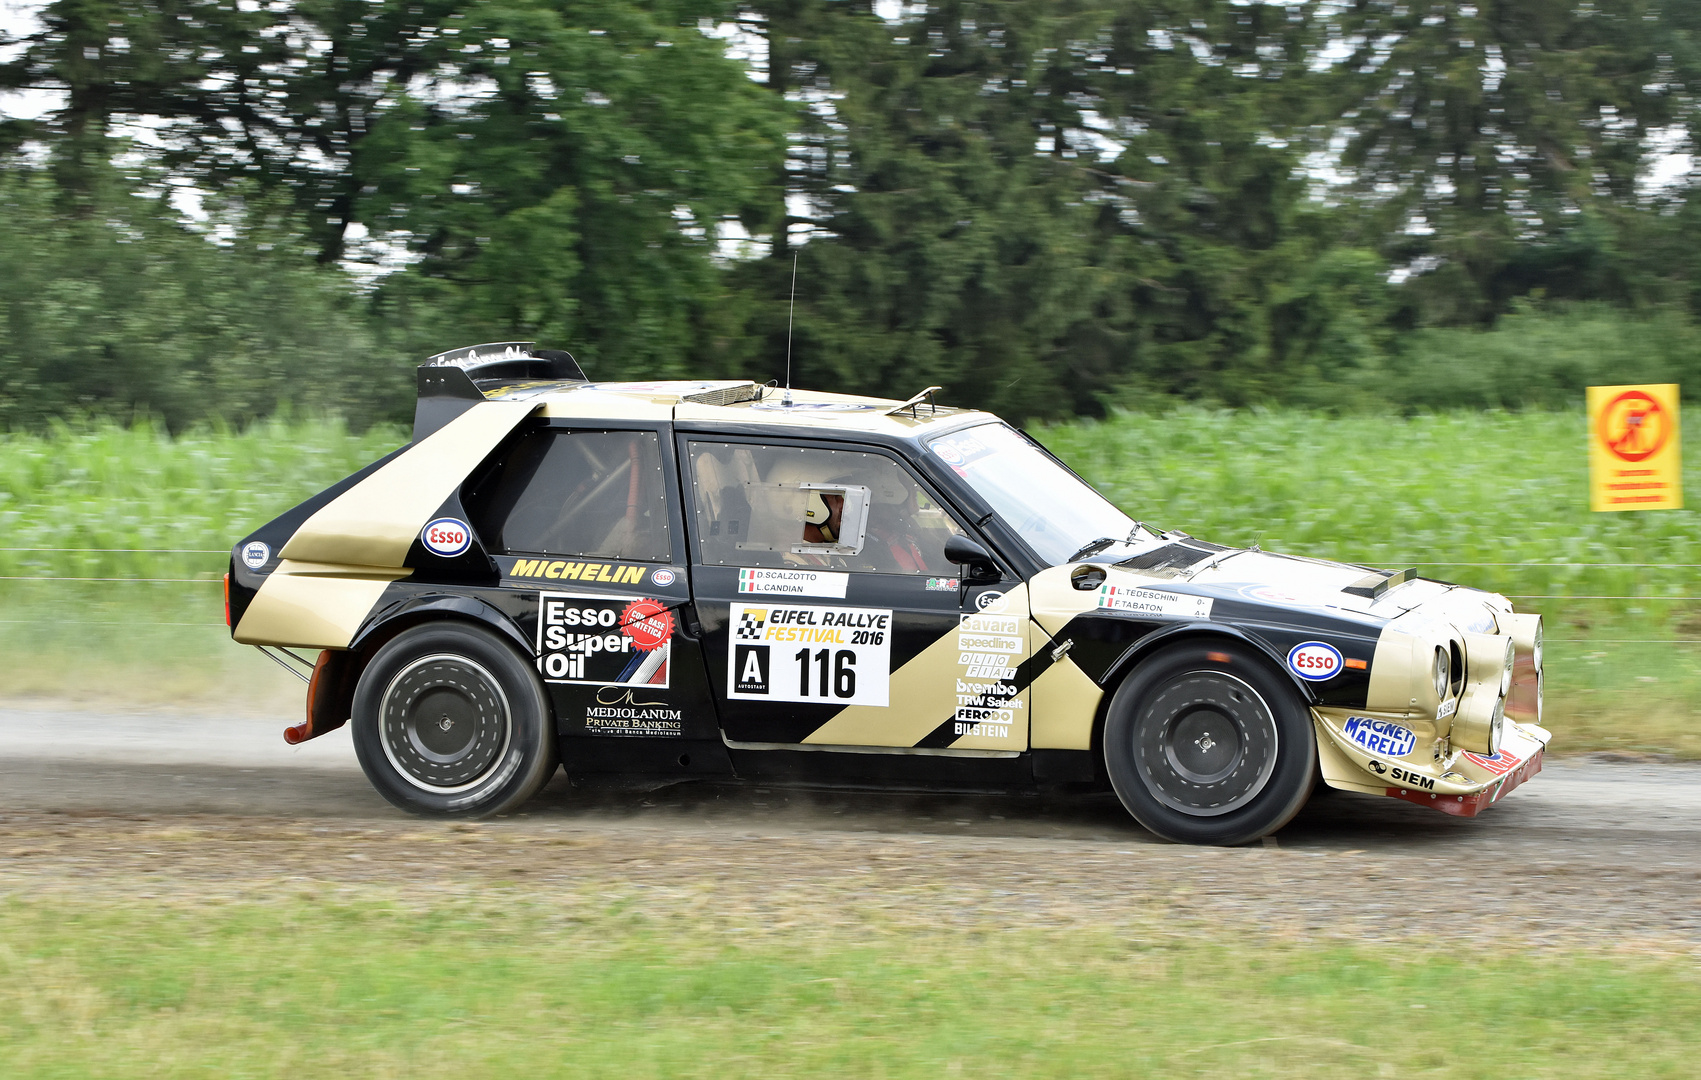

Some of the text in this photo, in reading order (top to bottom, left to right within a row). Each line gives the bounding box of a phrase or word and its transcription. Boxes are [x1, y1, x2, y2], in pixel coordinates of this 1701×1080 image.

[430, 528, 463, 545] Esso
[510, 559, 647, 585] MICHELIN
[655, 572, 672, 581] Esso
[756, 571, 817, 581] D.SCALZOTTO
[756, 583, 804, 593] L.CANDIAN
[1117, 588, 1178, 602] L.TEDESCHINI
[546, 601, 616, 627] Esso
[1114, 600, 1163, 612] F.TABATON
[647, 617, 666, 631] BASE
[770, 609, 889, 629] EIFEL RALLYE
[961, 615, 1017, 633] Savara
[628, 617, 662, 639] SINTETICA
[765, 626, 885, 646] FESTIVAL 2016
[545, 626, 634, 657] Super
[960, 636, 1016, 650] speedline
[545, 653, 585, 678] Oil
[741, 650, 763, 683] A
[961, 653, 1006, 665] OLIO
[1296, 652, 1334, 669] Esso
[795, 647, 857, 698] 116
[969, 667, 1016, 678] FIAT
[956, 678, 1017, 696] brembo
[956, 694, 1023, 709] TRW Sabelt
[586, 706, 682, 720] MEDIOLANUM
[957, 708, 1011, 721] FERODO
[954, 722, 1008, 738] BILSTEIN
[1391, 767, 1435, 790] SIEM
